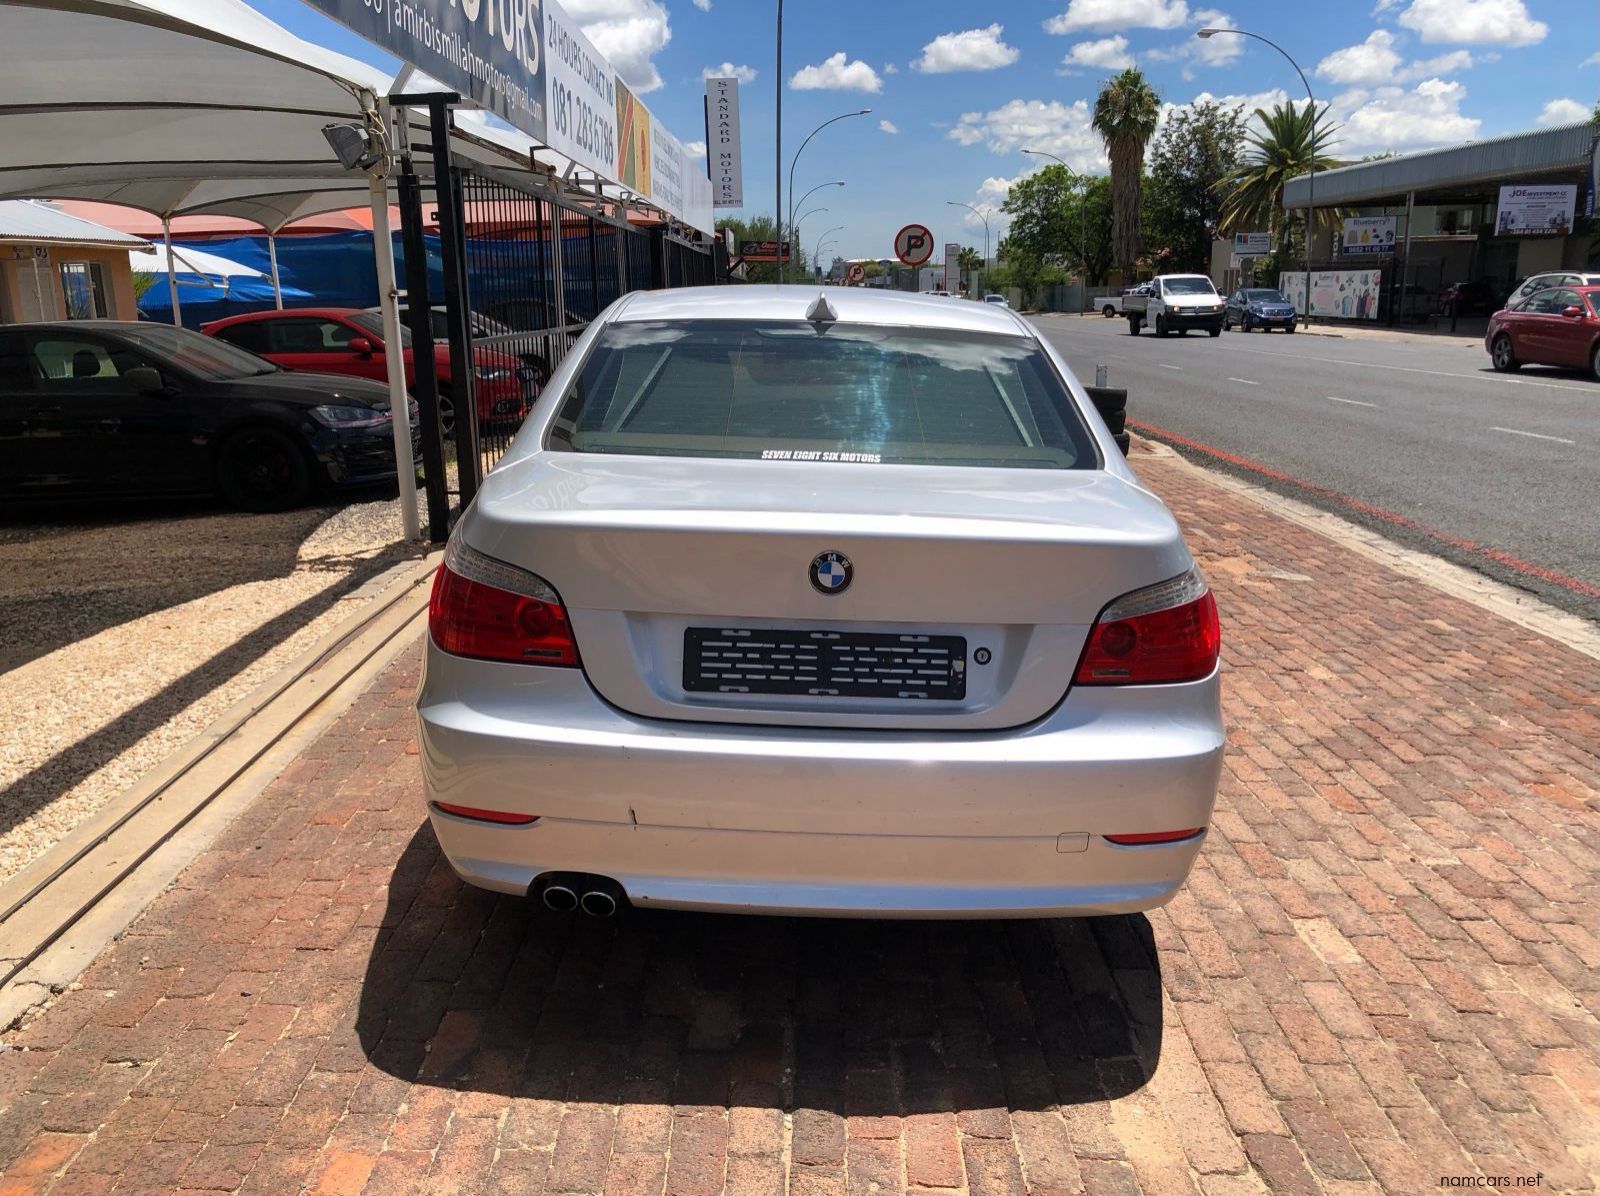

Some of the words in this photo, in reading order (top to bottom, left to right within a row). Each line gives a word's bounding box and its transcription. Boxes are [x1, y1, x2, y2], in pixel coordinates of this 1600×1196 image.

[395, 0, 542, 120] amirbismillahmotors@gmail.com
[450, 0, 539, 75] ORS
[548, 14, 557, 50] 24
[558, 24, 582, 76] HOURS
[582, 51, 605, 101] CONTACT
[552, 76, 573, 140] 081
[718, 81, 730, 143] STANDARD
[720, 153, 732, 198] MOTORS
[1511, 190, 1528, 198] JOE
[761, 450, 792, 459] SEVEN
[792, 451, 822, 460] EIGHT
[822, 452, 839, 461] SIX
[839, 452, 881, 463] MOTORS
[814, 553, 850, 568] BMW
